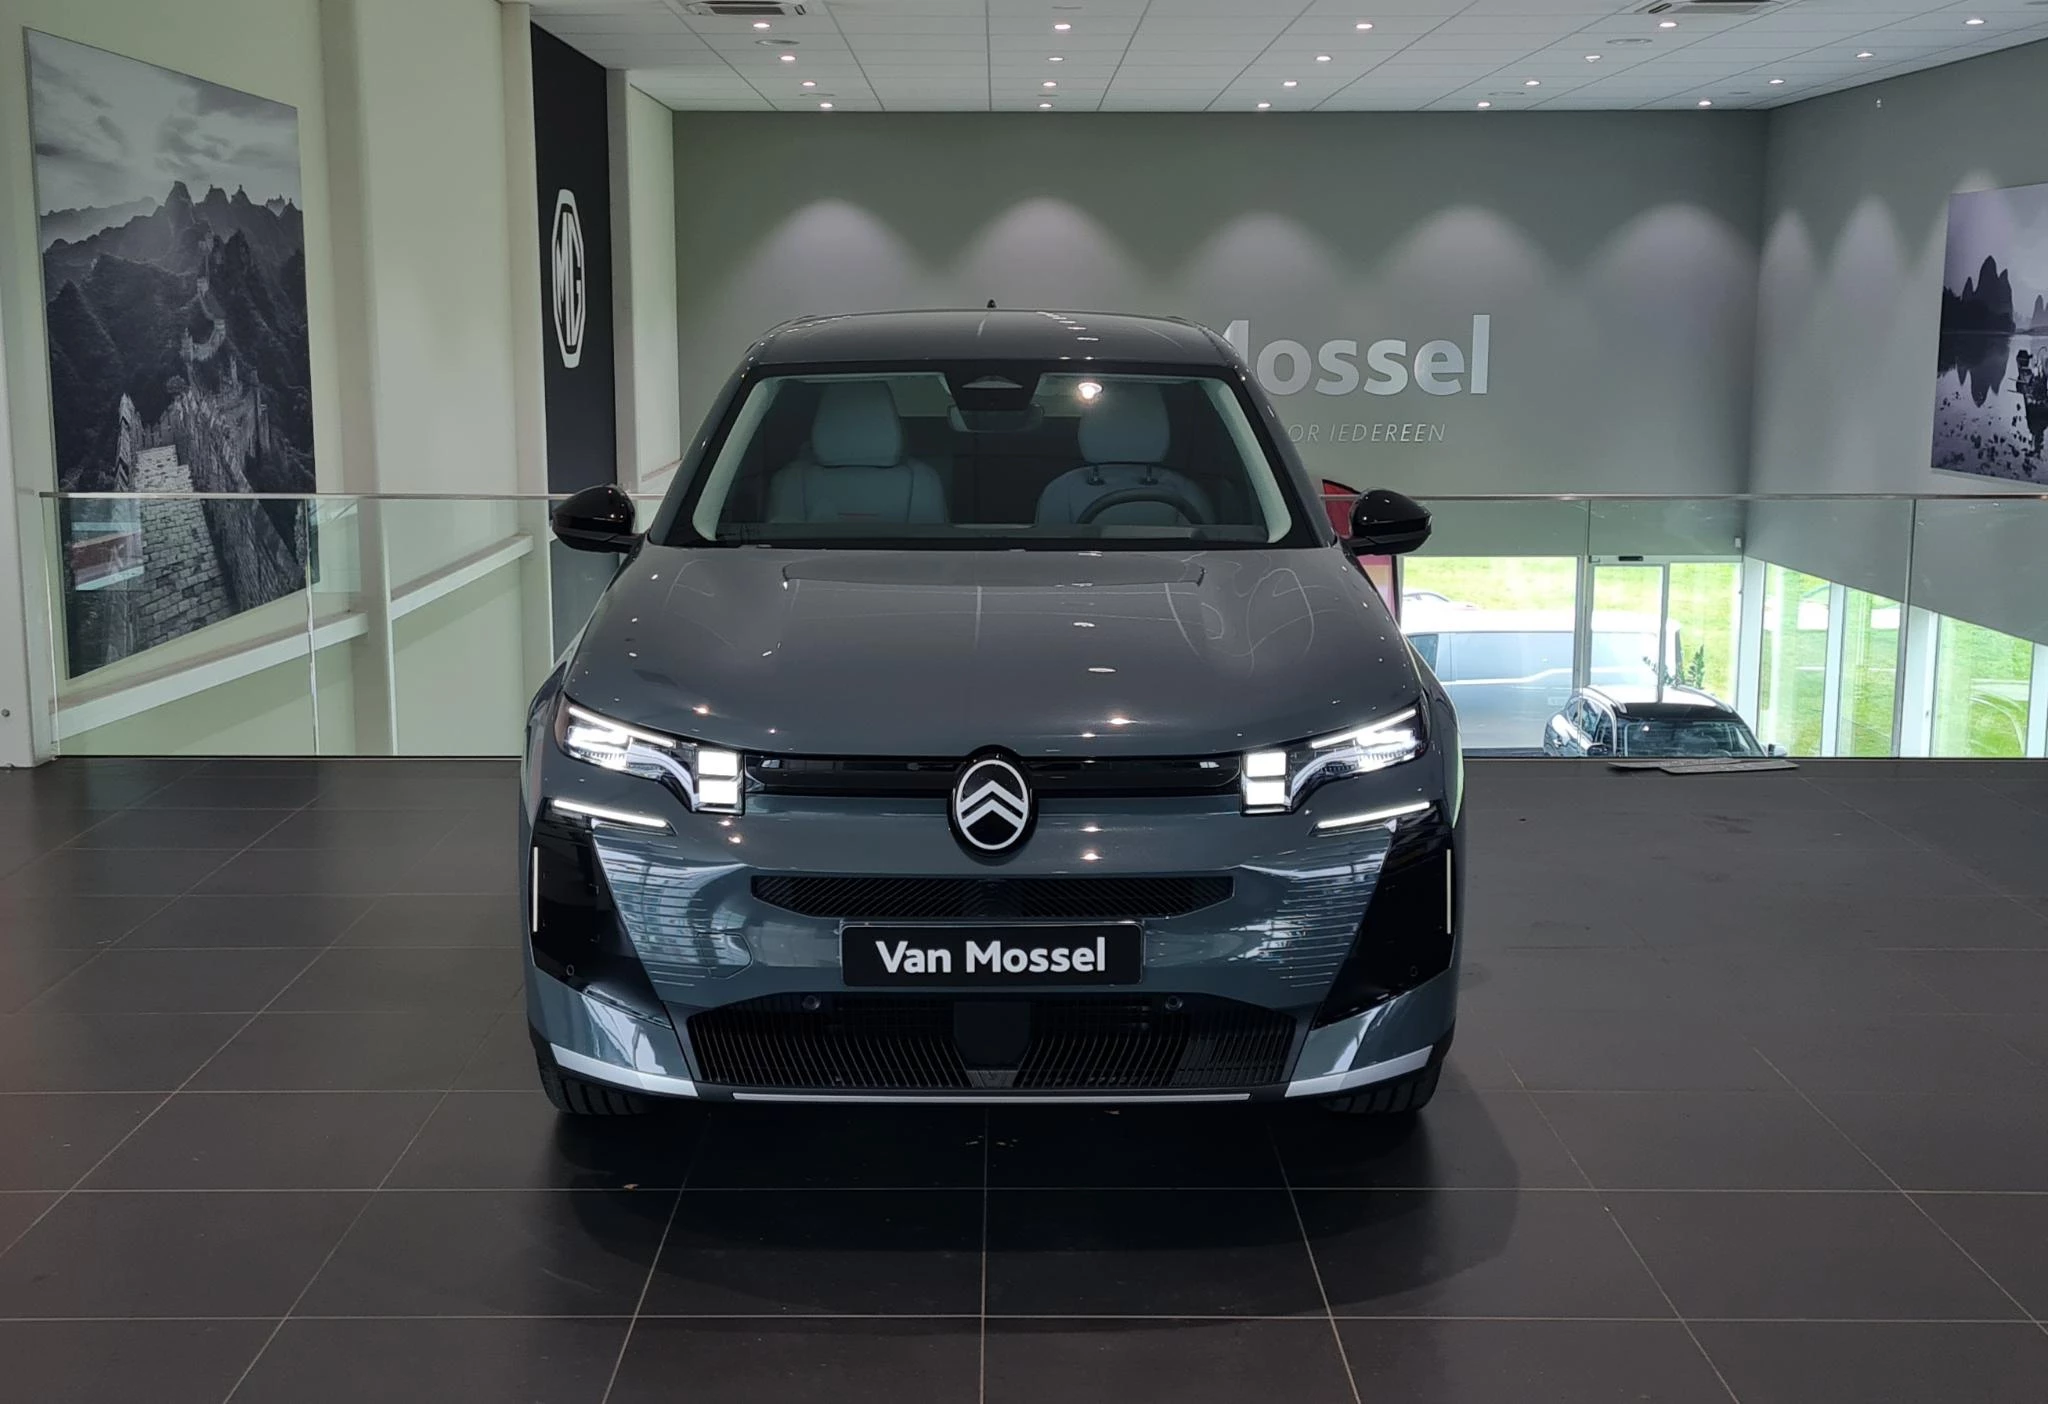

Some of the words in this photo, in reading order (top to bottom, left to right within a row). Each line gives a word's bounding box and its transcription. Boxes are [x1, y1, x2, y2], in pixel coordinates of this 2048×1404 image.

[554, 210, 582, 347] MG
[1329, 423, 1446, 442] IEDEREEN
[875, 940, 952, 973] Van
[965, 936, 1106, 973] Mossel
